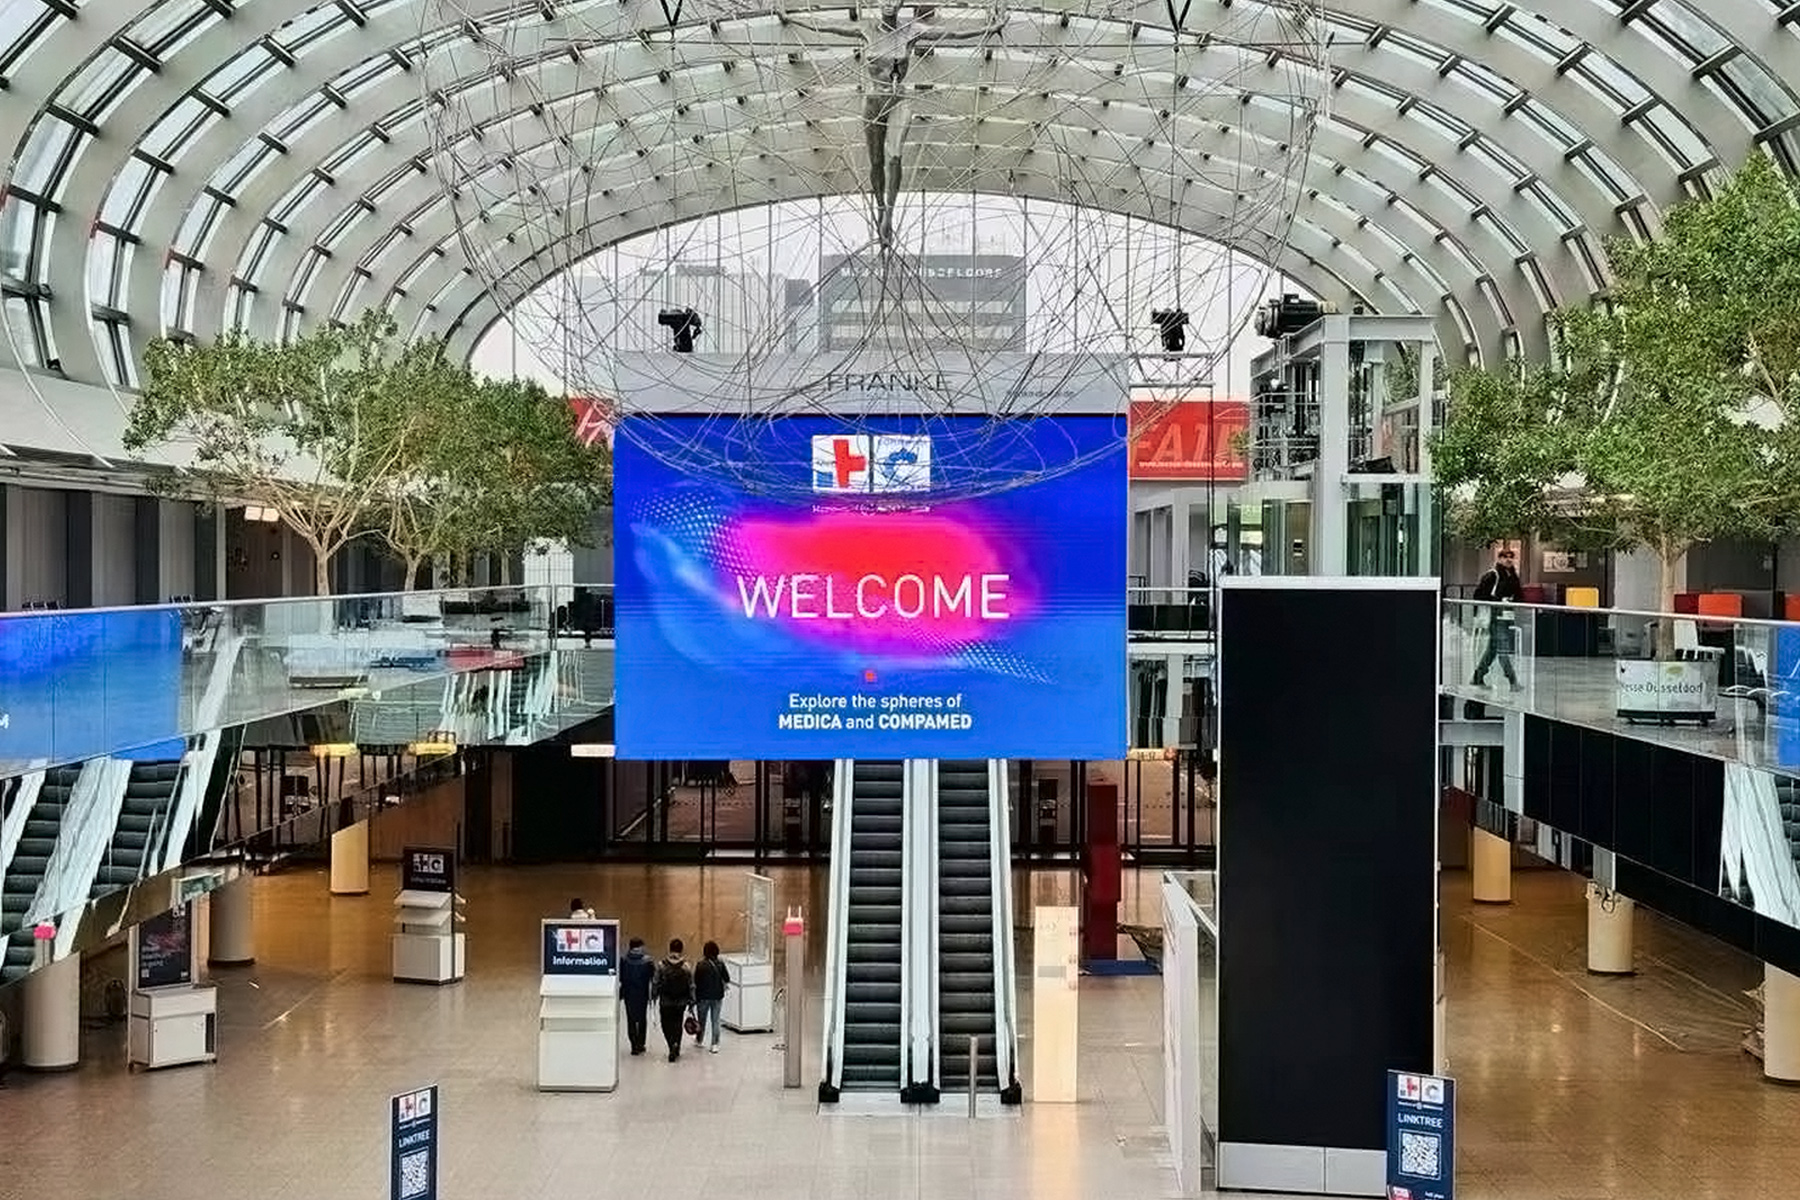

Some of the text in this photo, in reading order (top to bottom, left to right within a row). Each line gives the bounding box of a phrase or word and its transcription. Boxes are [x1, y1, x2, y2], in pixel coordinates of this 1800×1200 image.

[826, 372, 952, 392] FRANKE
[737, 573, 1010, 619] WELCOME
[788, 692, 963, 712] Explore the spheres of
[778, 714, 973, 730] MEDICA and COMPAMED
[552, 955, 608, 966] Information
[1398, 1112, 1443, 1129] LINKTREE
[399, 1129, 430, 1148] LINKTREE
